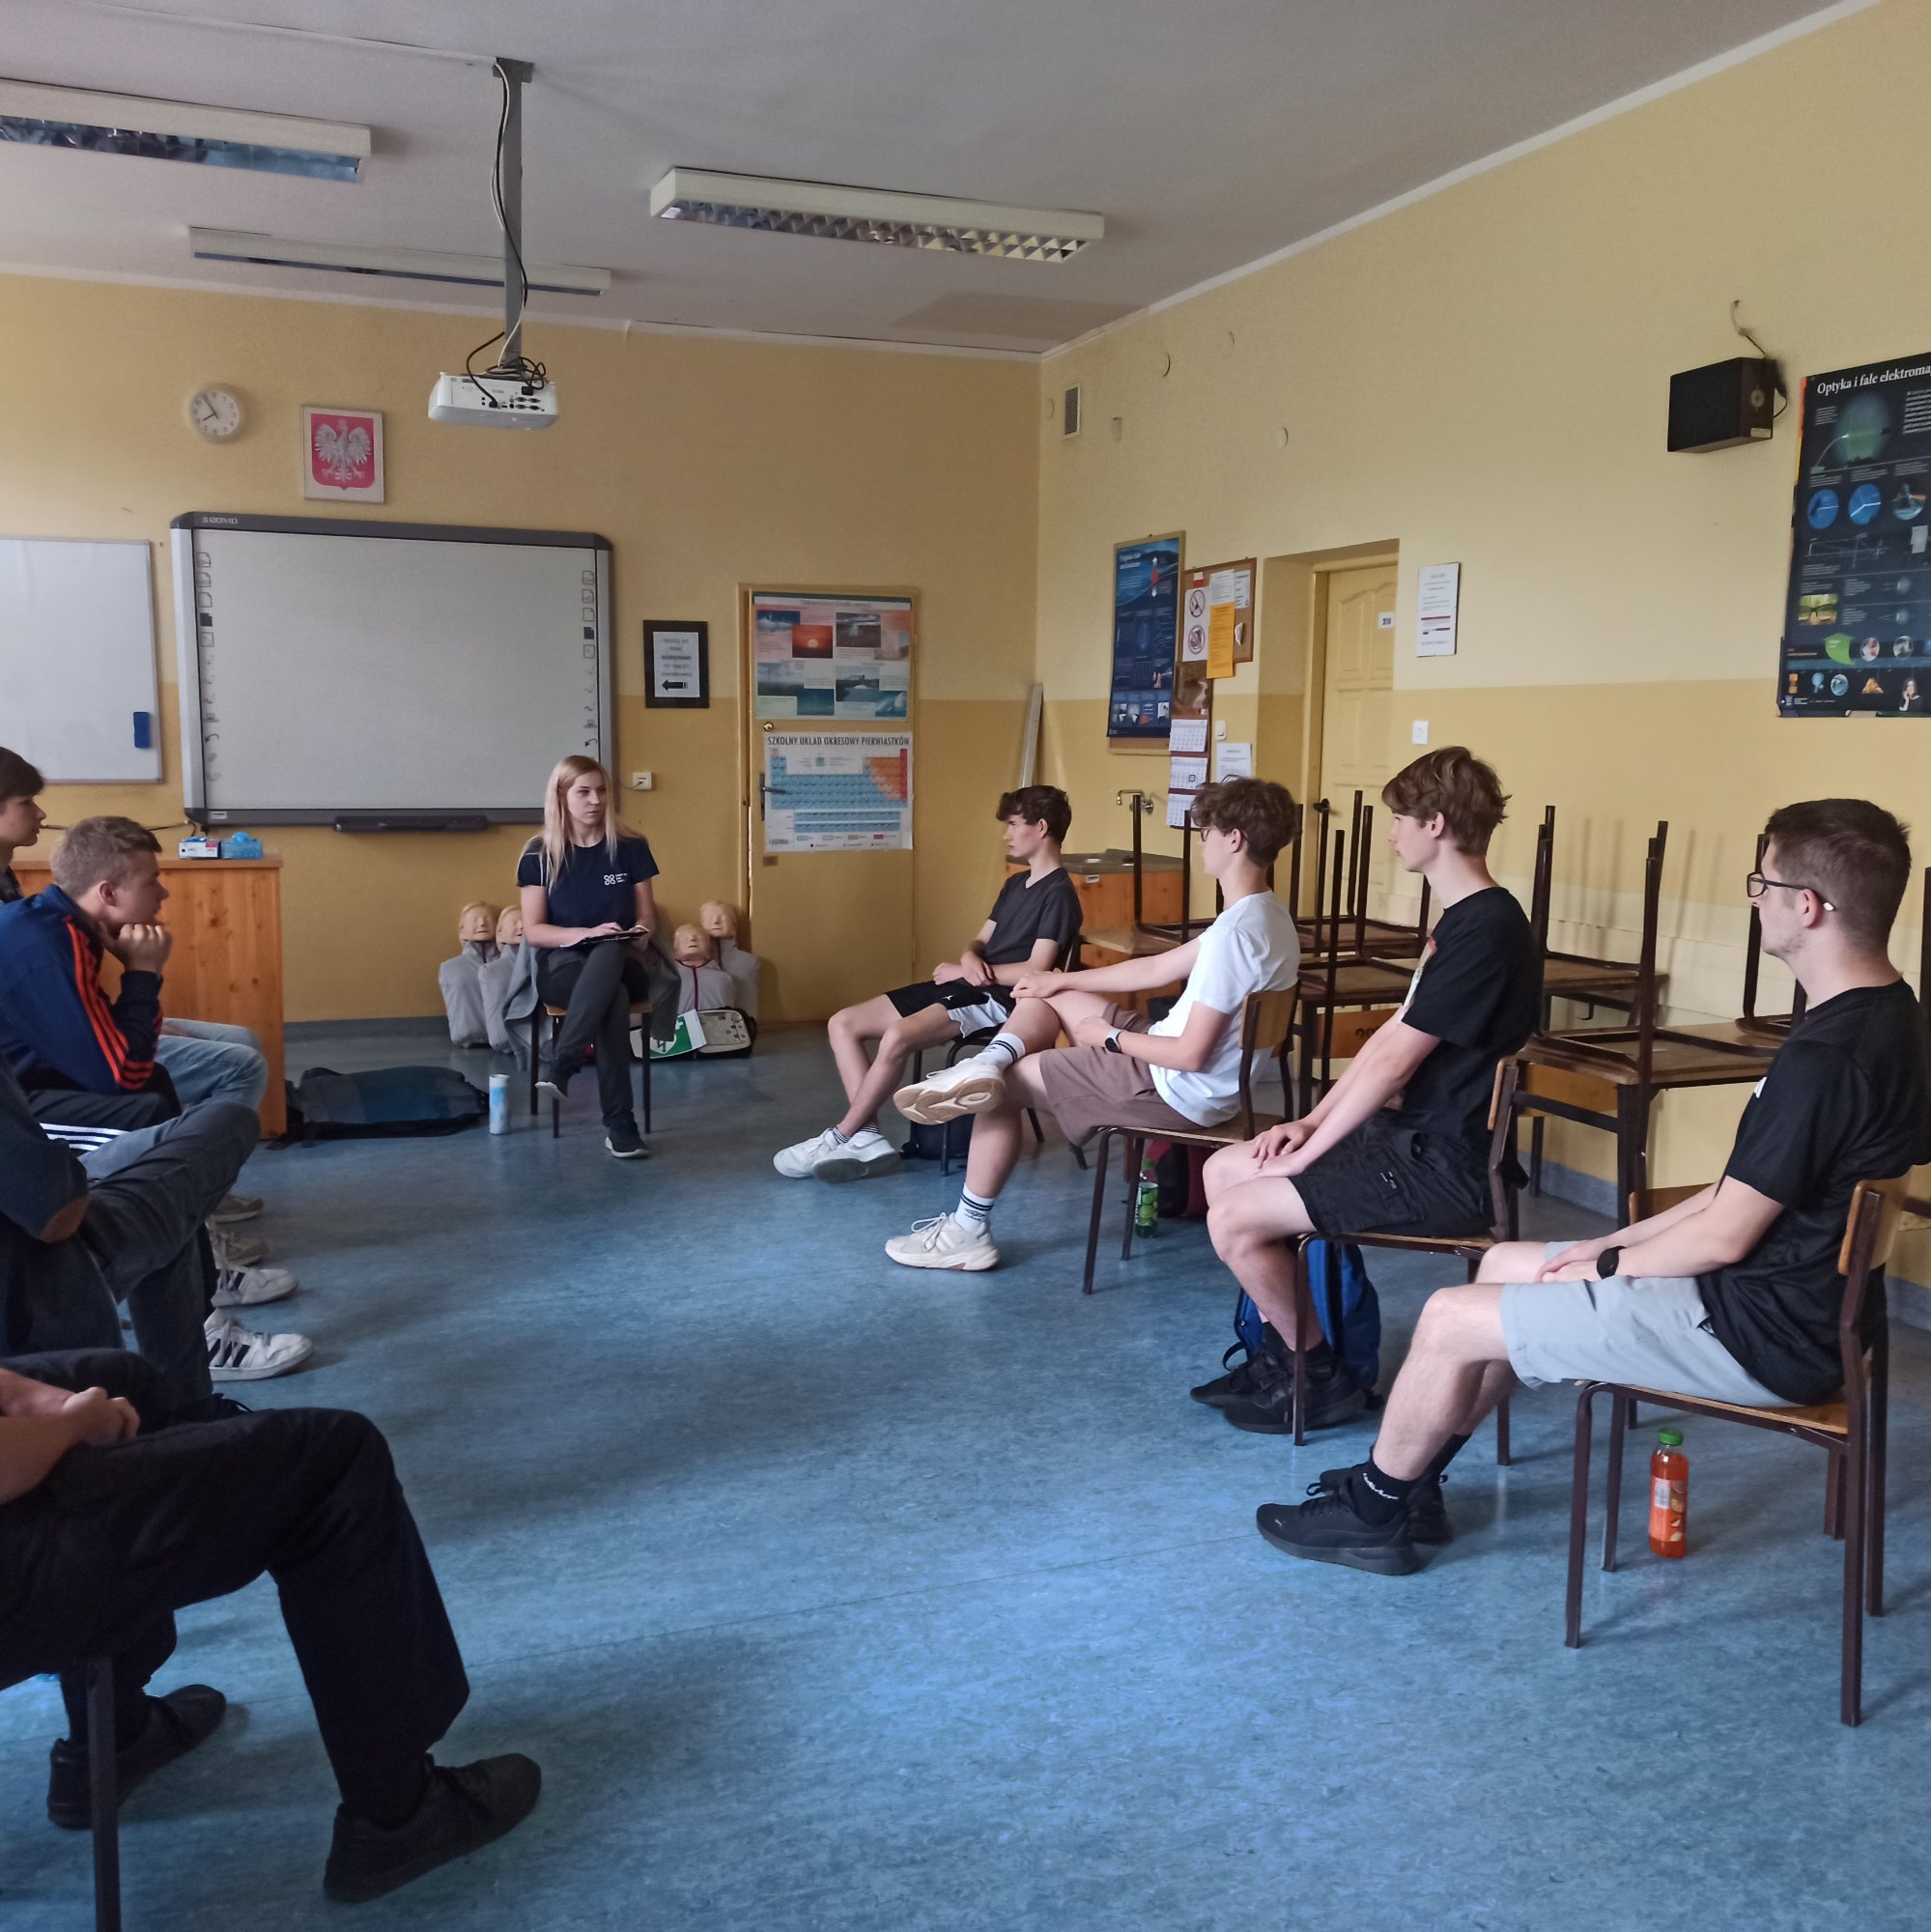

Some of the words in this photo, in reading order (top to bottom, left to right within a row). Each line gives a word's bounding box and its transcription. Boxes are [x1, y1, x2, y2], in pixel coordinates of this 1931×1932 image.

[1817, 379, 1852, 396] Optyka
[1854, 377, 1859, 387] i
[1860, 373, 1878, 386] fale
[1880, 365, 1931, 383] elektroma
[767, 736, 798, 746] SZKOLNY
[824, 736, 860, 746] OKRESOWY
[861, 735, 910, 746] PIERWIASTKÓW
